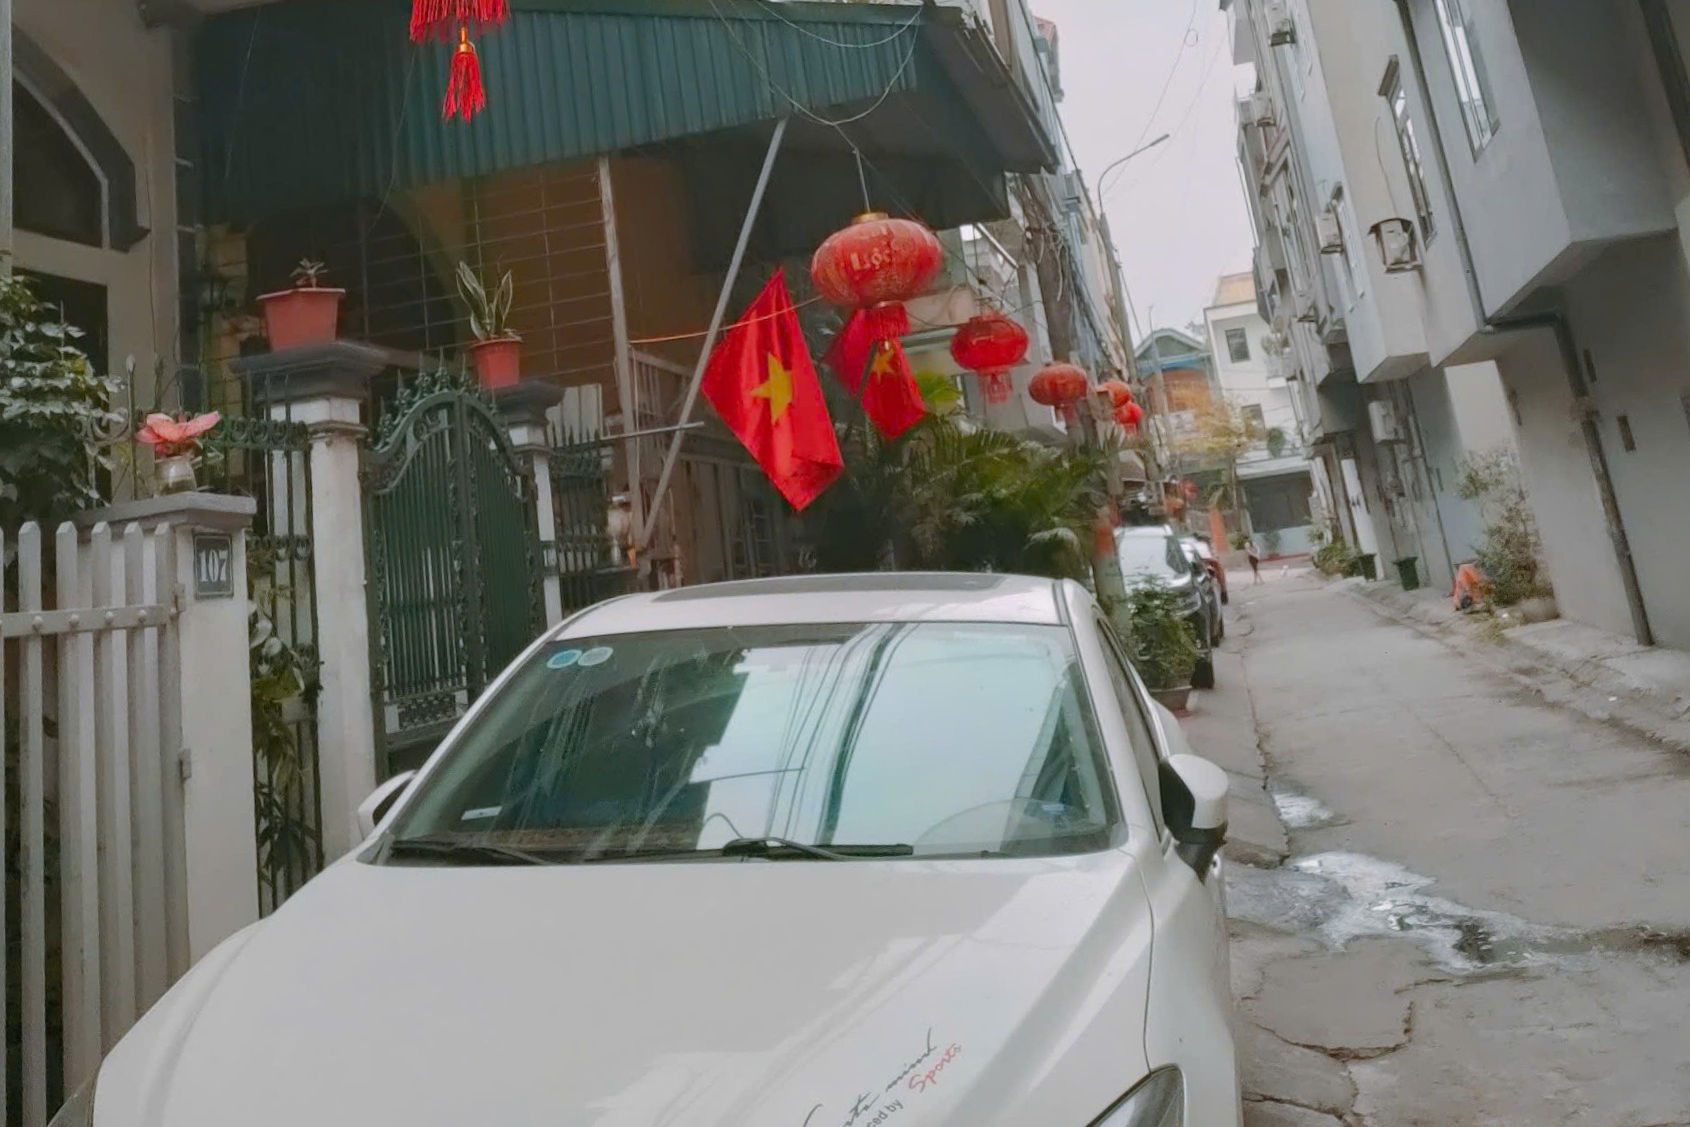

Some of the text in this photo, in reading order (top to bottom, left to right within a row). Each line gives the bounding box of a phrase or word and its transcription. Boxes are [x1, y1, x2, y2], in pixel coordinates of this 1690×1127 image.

[198, 549, 229, 582] 107
[886, 1098, 904, 1113] by
[908, 1043, 962, 1093] Sports
